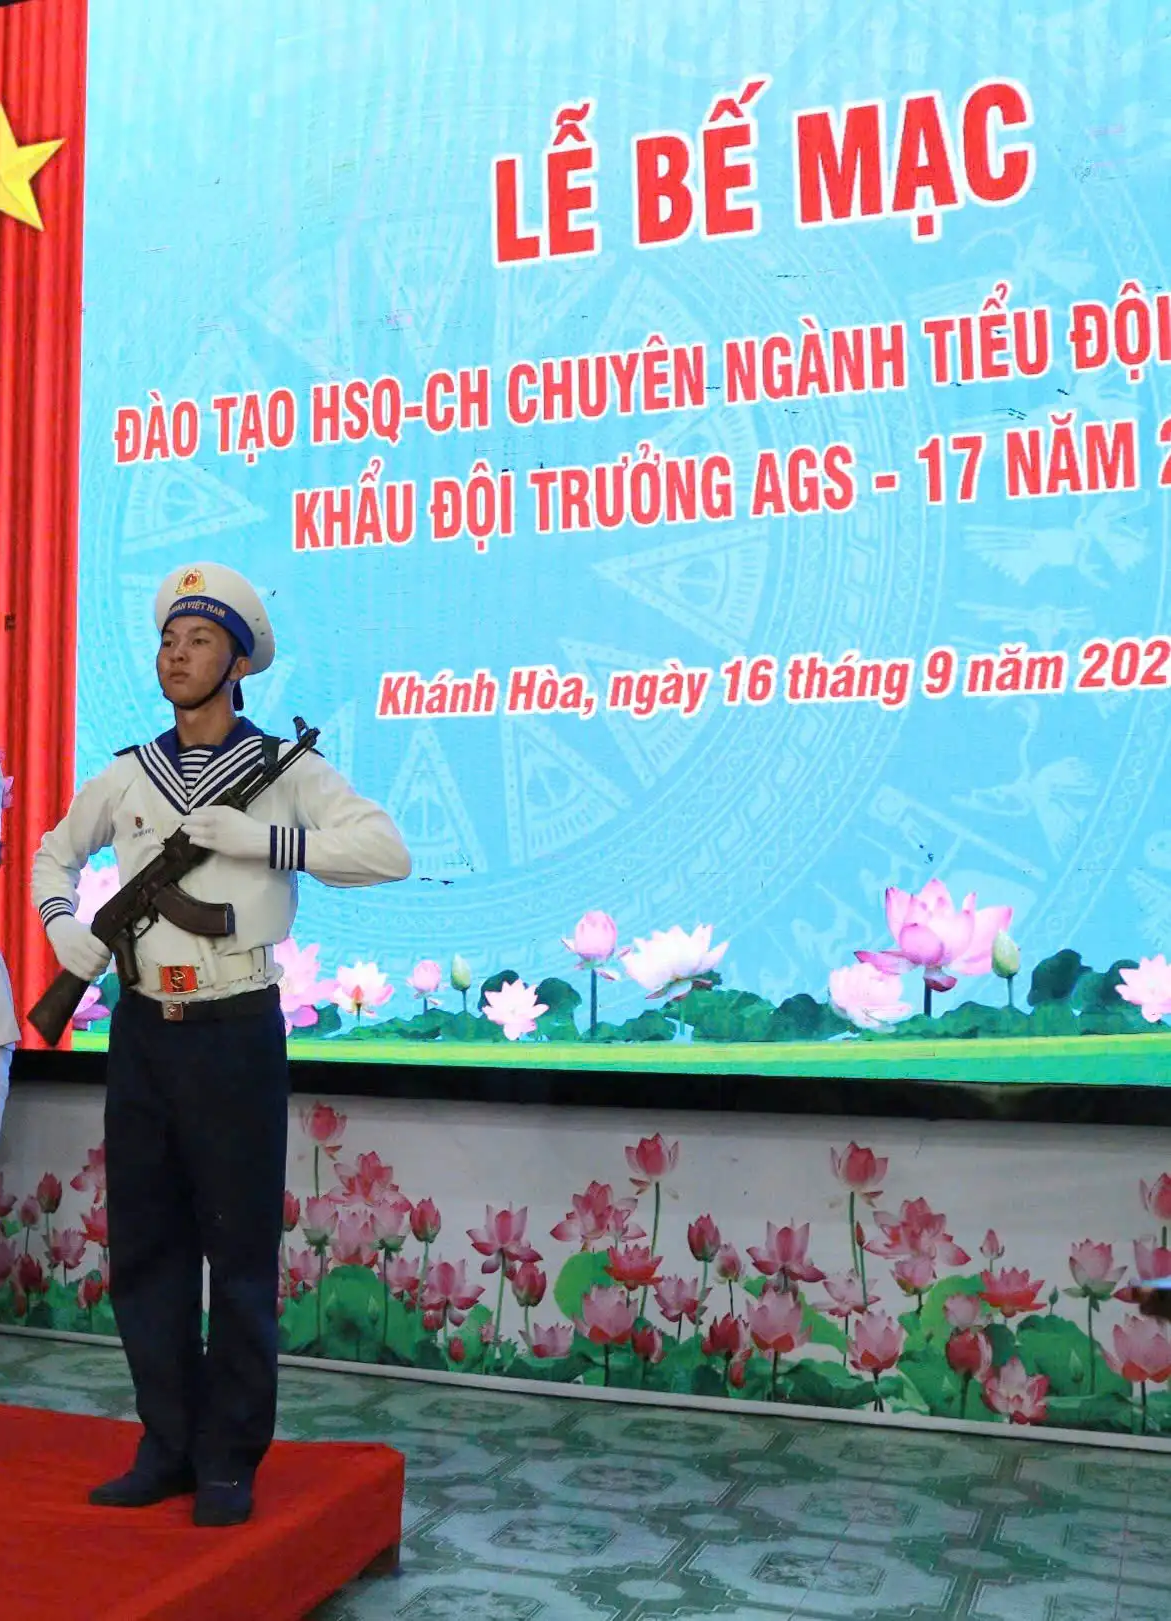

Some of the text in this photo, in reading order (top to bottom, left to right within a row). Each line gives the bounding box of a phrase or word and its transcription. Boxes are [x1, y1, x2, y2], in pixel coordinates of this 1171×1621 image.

[496, 80, 1030, 262] LỄ BẾ MẠC
[114, 281, 1171, 464] ĐÀO TẠO HSQ-CH CHUYÊN NGÀNH TIỂU ĐỘI
[295, 459, 414, 550] KHẨU
[429, 461, 512, 551] ĐỘI
[529, 442, 732, 532] TRƯỞNG
[752, 444, 854, 516] AGS
[875, 474, 897, 489] -
[918, 435, 983, 503] 17
[1006, 412, 1136, 497] NĂM
[206, 603, 226, 617] NAM
[379, 672, 496, 716] Khánh
[508, 670, 594, 716] Hòa,
[609, 663, 708, 716] ngày
[724, 658, 774, 703] 16
[788, 655, 910, 706] tháng
[924, 649, 954, 694] 9
[967, 647, 1064, 693] năm
